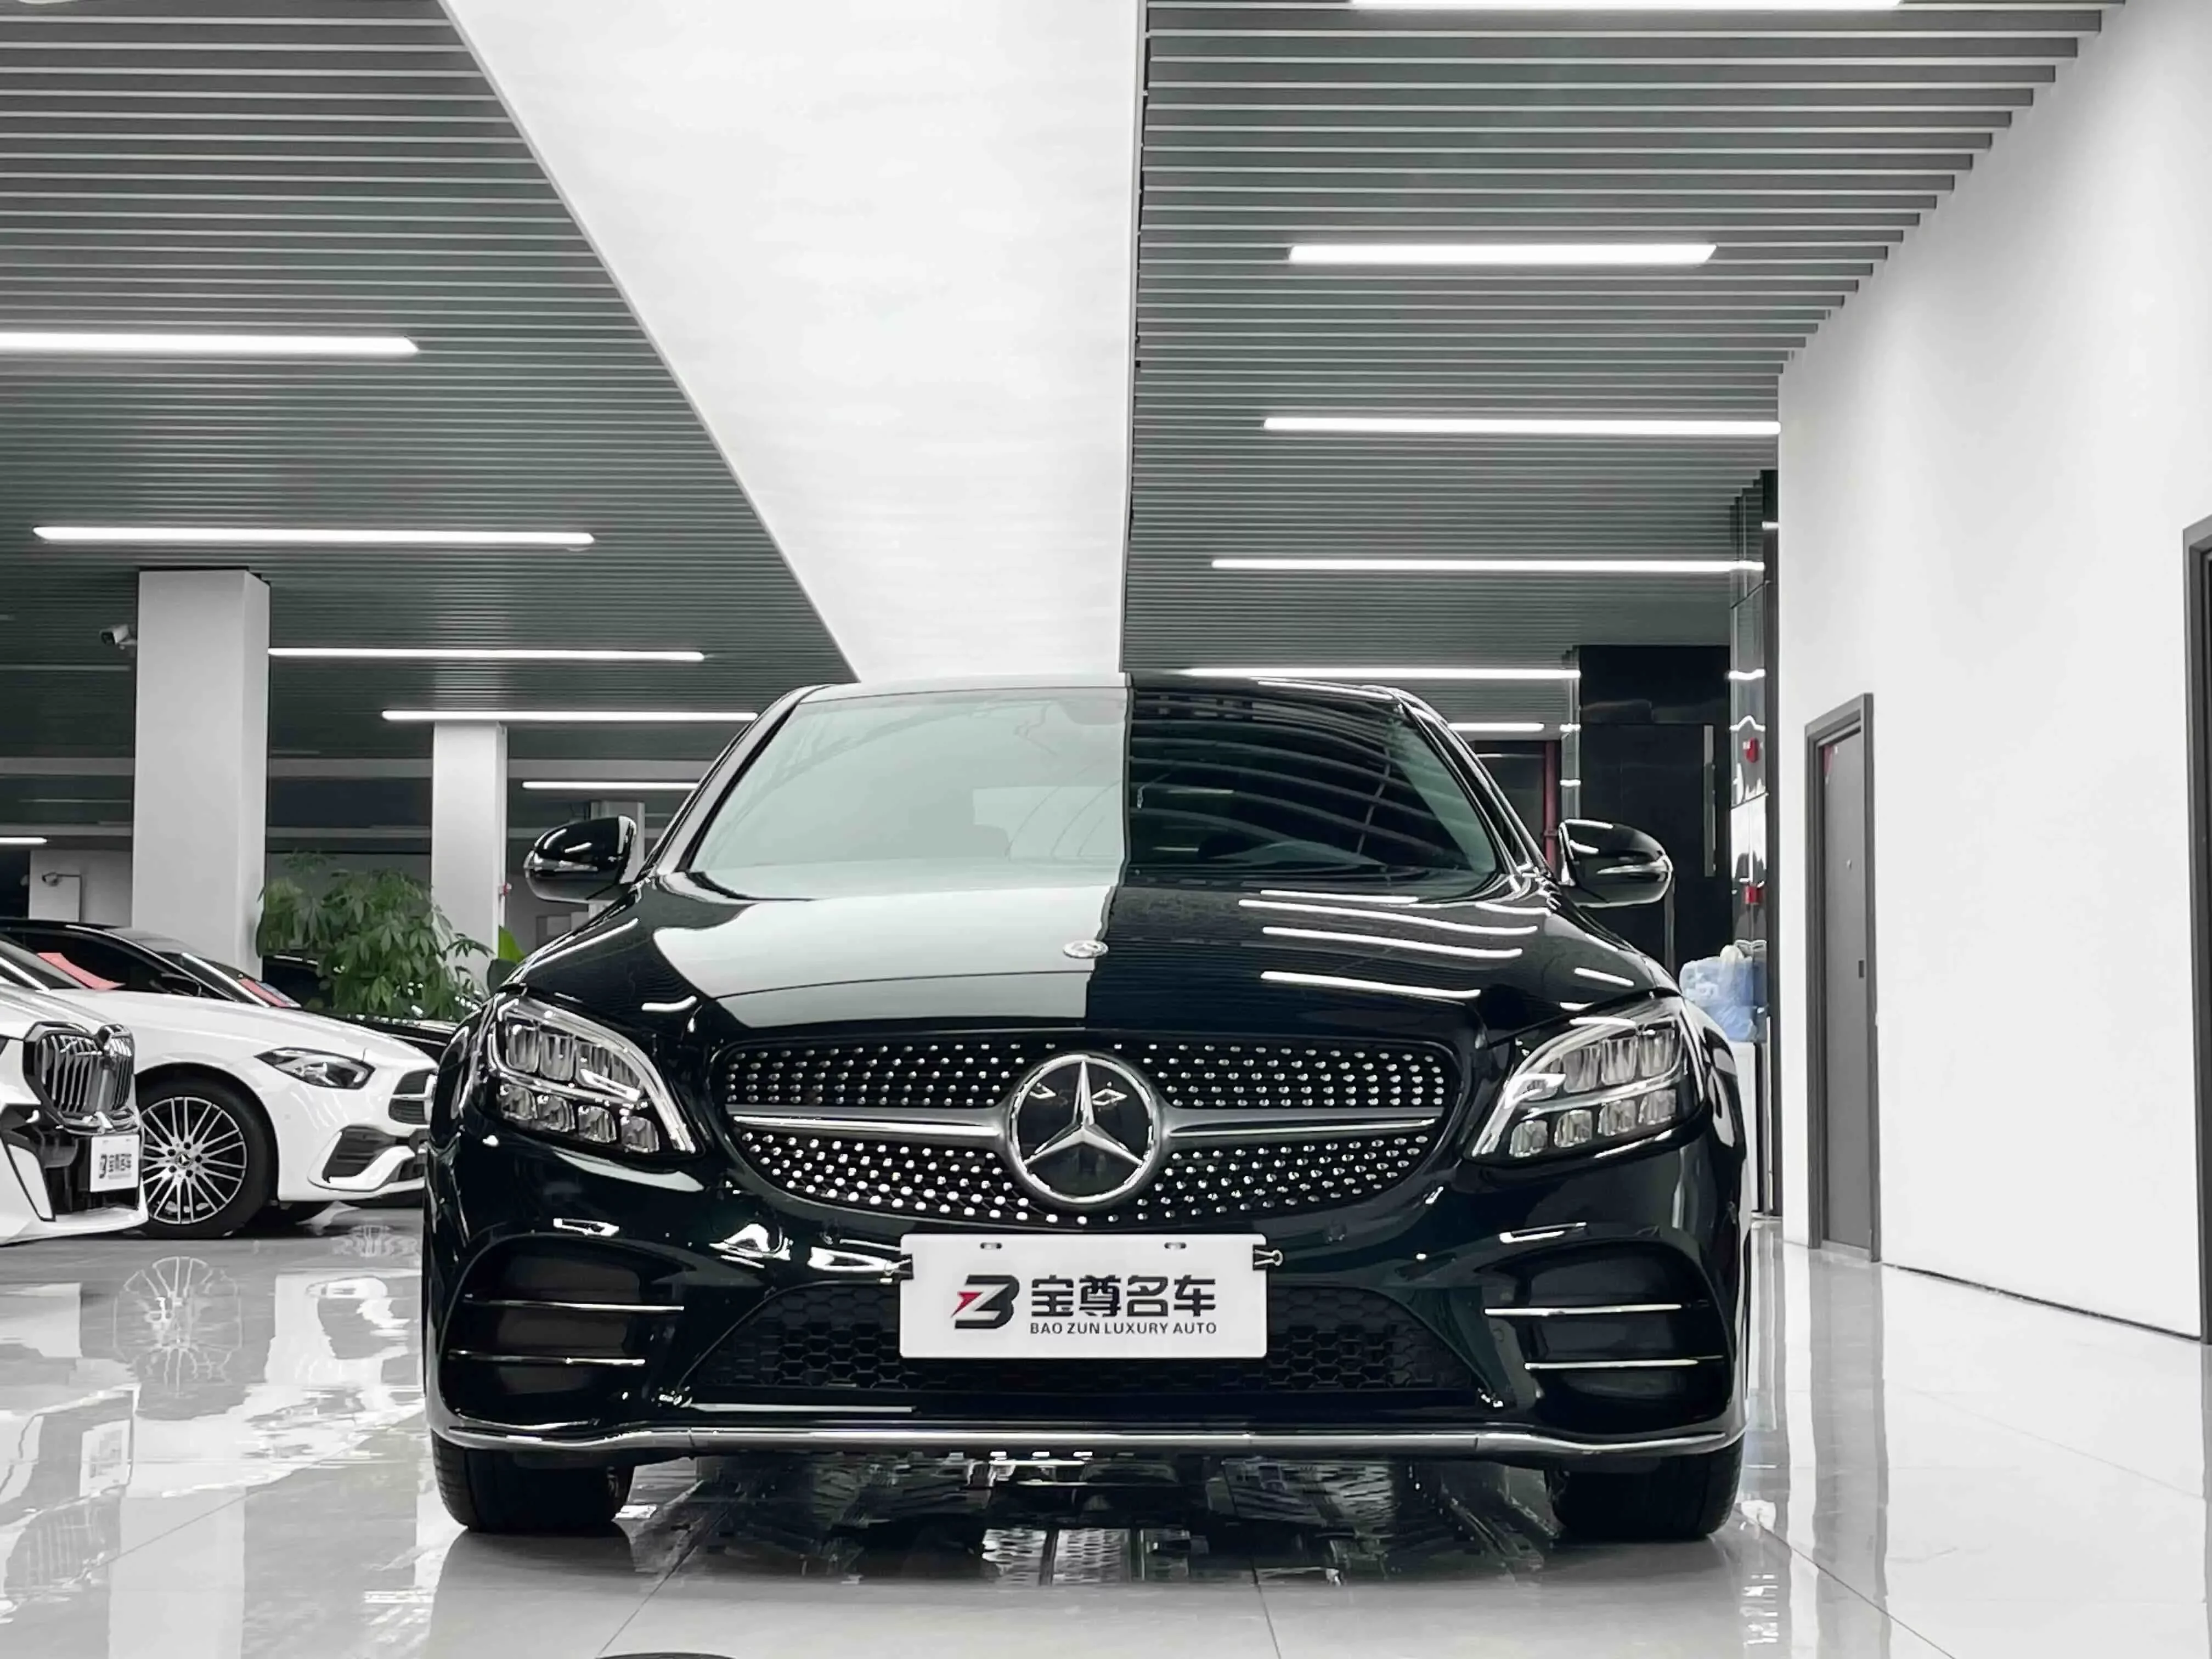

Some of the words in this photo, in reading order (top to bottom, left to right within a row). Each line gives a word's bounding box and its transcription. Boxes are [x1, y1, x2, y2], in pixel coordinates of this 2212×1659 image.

[1031, 1274, 1217, 1317] 宝尊名车
[1030, 1322, 1063, 1335] BAO
[1066, 1322, 1100, 1335] ZUN
[1104, 1322, 1168, 1335] LUXURY
[1172, 1322, 1217, 1335] AUTO
